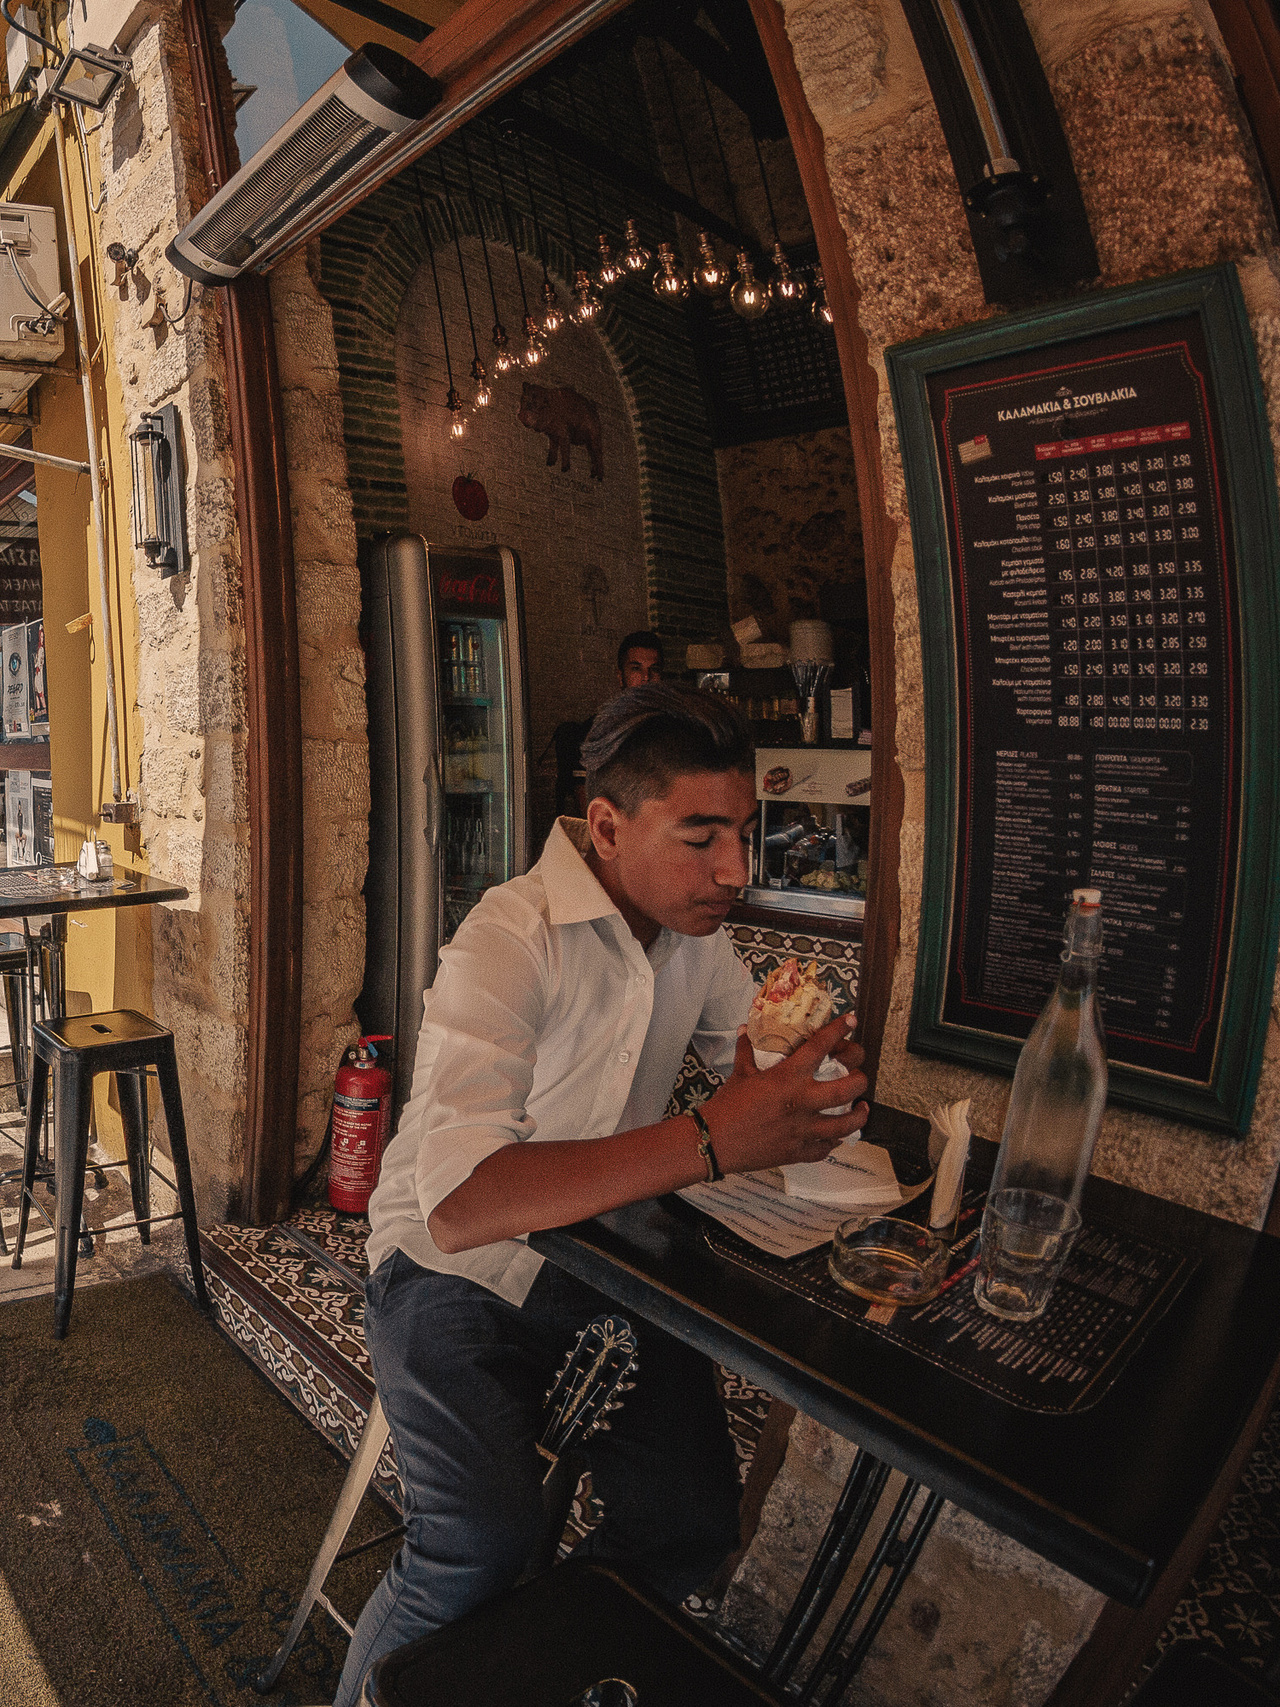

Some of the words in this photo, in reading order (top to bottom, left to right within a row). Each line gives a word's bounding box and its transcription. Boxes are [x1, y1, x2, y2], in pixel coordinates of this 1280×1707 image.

[997, 401, 1061, 422] ΚΑΛΑΜΑΚΙΑ
[1063, 398, 1072, 410] &
[1073, 386, 1138, 409] ΣΟΥΒΛΑΚΙΑ
[1049, 472, 1062, 483] 1.50
[1070, 468, 1087, 480] 2.40
[1096, 465, 1113, 477] 3.80
[1122, 461, 1138, 473] 3.40
[1147, 458, 1163, 470] 3.20
[1173, 454, 1190, 467] 2.90
[1049, 493, 1065, 504] 2.50
[1074, 490, 1089, 501] 3.30
[1098, 487, 1115, 499] 5.80
[1124, 484, 1141, 495] 4.20
[1149, 481, 1166, 492] 4.20
[1176, 478, 1193, 490] 3.80
[1054, 516, 1068, 526] 1.50
[1076, 513, 1092, 524] 2.40
[1102, 510, 1118, 521] 3.80
[1127, 508, 1144, 519] 3.40
[1153, 505, 1169, 517] 3.20
[1178, 502, 1196, 514] 2.90
[1056, 539, 1070, 549] 1.60
[1078, 536, 1094, 548] 2.50
[1104, 534, 1120, 545] 3.90
[1130, 532, 1146, 543] 3.40
[1155, 529, 1172, 541] 3.30
[1182, 527, 1199, 539] 3.00
[1059, 570, 1073, 580] 1.95
[1081, 568, 1097, 579] 2.85
[1106, 566, 1124, 577] 4.20
[1133, 564, 1149, 575] 3.80
[1158, 562, 1174, 574] 3.50
[1185, 560, 1202, 572] 3.35
[1082, 593, 1099, 604] 2.85
[1109, 591, 1125, 602] 3.80
[1160, 588, 1177, 600] 3.20
[1187, 587, 1203, 598] 3.35
[1062, 617, 1076, 628] 1.40
[1084, 616, 1100, 627] 2.20
[1111, 615, 1127, 626] 3.50
[1162, 613, 1178, 624] 3.20
[1064, 640, 1077, 651] 1.20
[1085, 640, 1101, 650] 2.00
[1162, 637, 1179, 648] 2.85
[1189, 637, 1206, 648] 2.50
[1065, 665, 1078, 675] 1.50
[1086, 664, 1103, 675] 2.40
[1139, 663, 1154, 674] 3.40
[1164, 663, 1180, 674] 3.20
[1190, 663, 1207, 674] 2.90
[1066, 695, 1079, 705] 1.80
[1087, 695, 1103, 705] 2.80
[1140, 695, 1156, 706] 3.40
[1165, 696, 1181, 706] 3.20
[1192, 696, 1208, 707] 3.30
[1090, 717, 1104, 727] 1.80
[1191, 719, 1208, 730] 2.30
